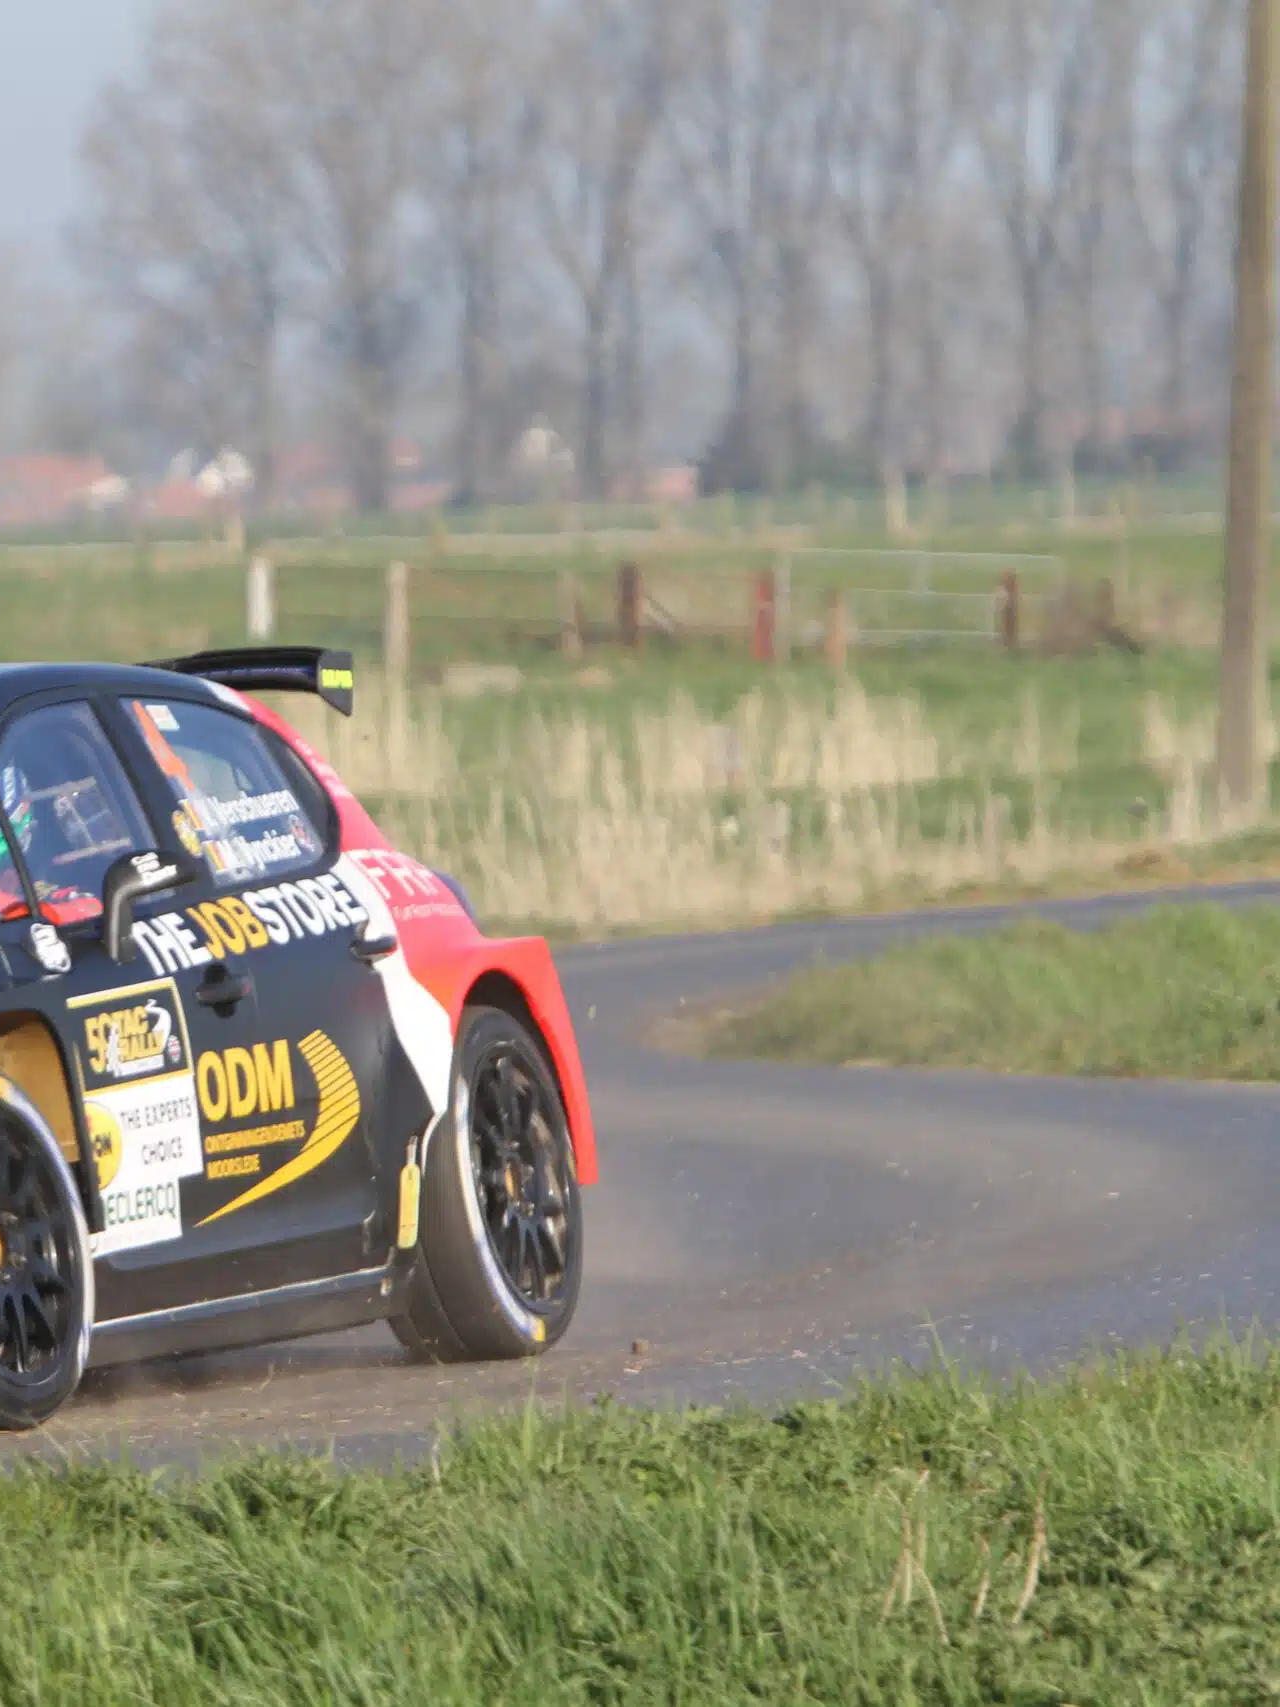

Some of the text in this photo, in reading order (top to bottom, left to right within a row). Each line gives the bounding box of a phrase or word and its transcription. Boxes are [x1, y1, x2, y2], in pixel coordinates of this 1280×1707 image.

[196, 1038, 295, 1123] ODM
[120, 1096, 193, 1129] THE EXPERTS
[141, 1136, 184, 1165] CHOICE
